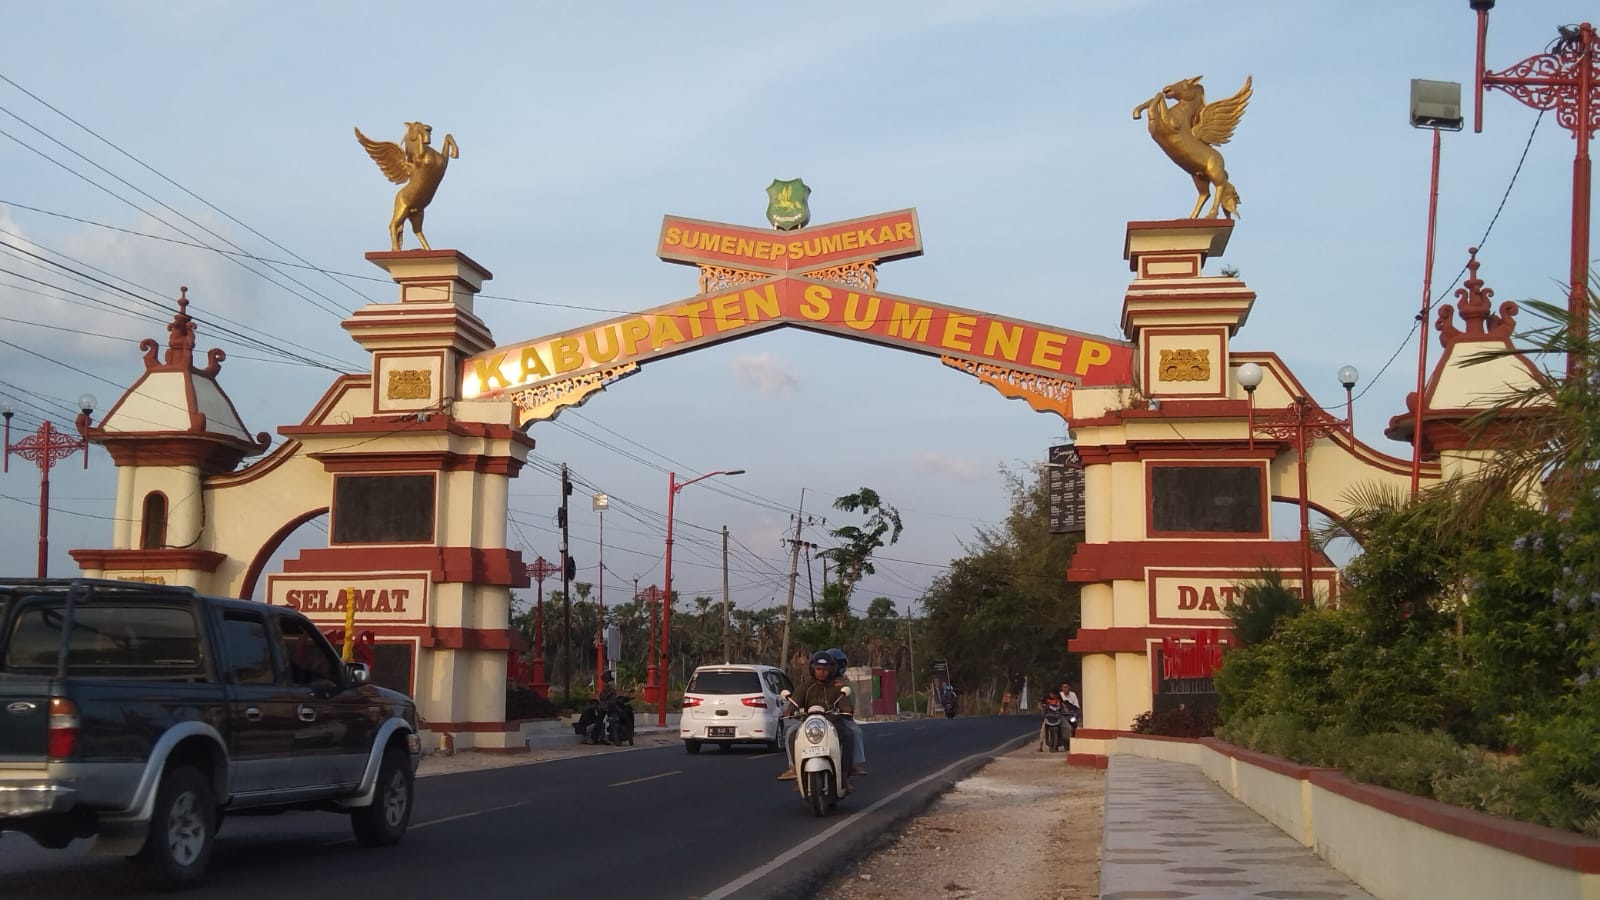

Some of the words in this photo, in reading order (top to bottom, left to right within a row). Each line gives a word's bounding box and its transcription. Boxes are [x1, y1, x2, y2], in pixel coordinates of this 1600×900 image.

[474, 284, 781, 393] KABUPATEN
[799, 284, 1112, 376] SUMENEP
[286, 589, 409, 612] SELAMAT
[1177, 586, 1304, 611] DAT
